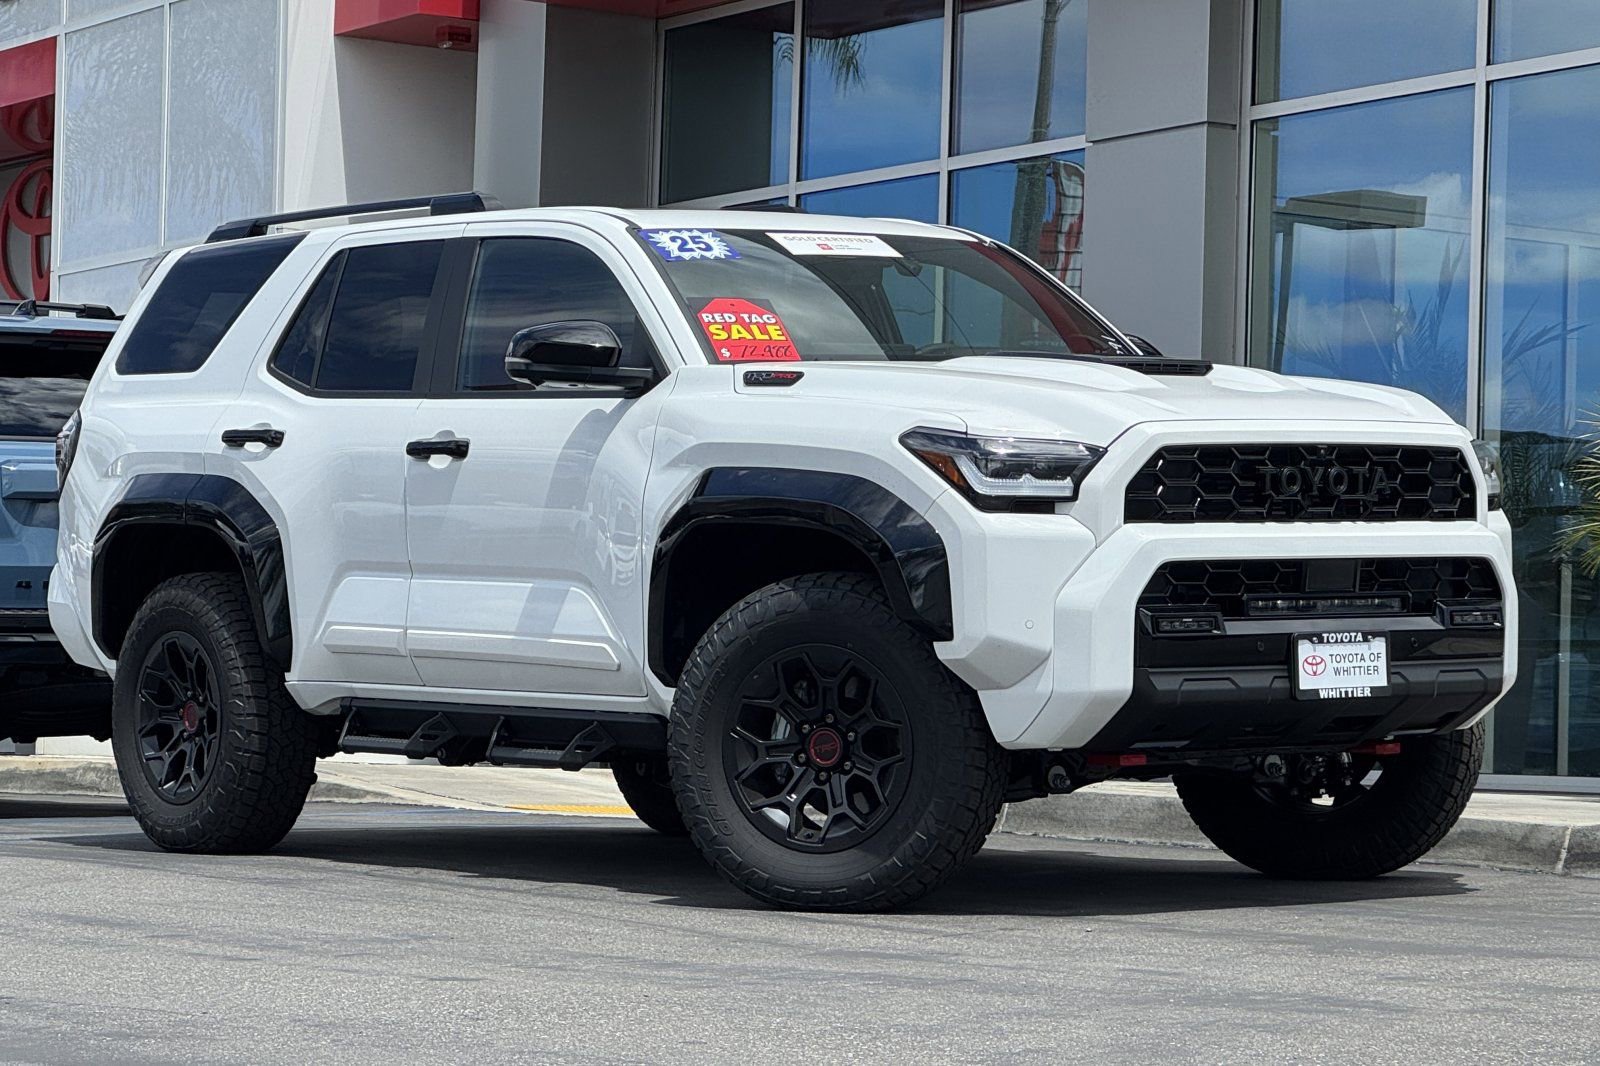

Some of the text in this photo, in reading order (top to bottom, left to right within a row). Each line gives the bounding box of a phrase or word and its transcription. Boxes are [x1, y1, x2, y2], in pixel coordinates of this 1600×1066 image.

[669, 235, 714, 254] 25
[701, 313, 777, 324] RED TAG
[708, 324, 788, 341] SALE
[720, 347, 731, 358] $
[1257, 465, 1392, 496] TOYOTA
[1322, 632, 1364, 643] TOYOTA
[1328, 652, 1382, 664] TOYOTA OF
[1332, 665, 1380, 677] WHITTIER
[1319, 687, 1372, 699] WHITTIER
